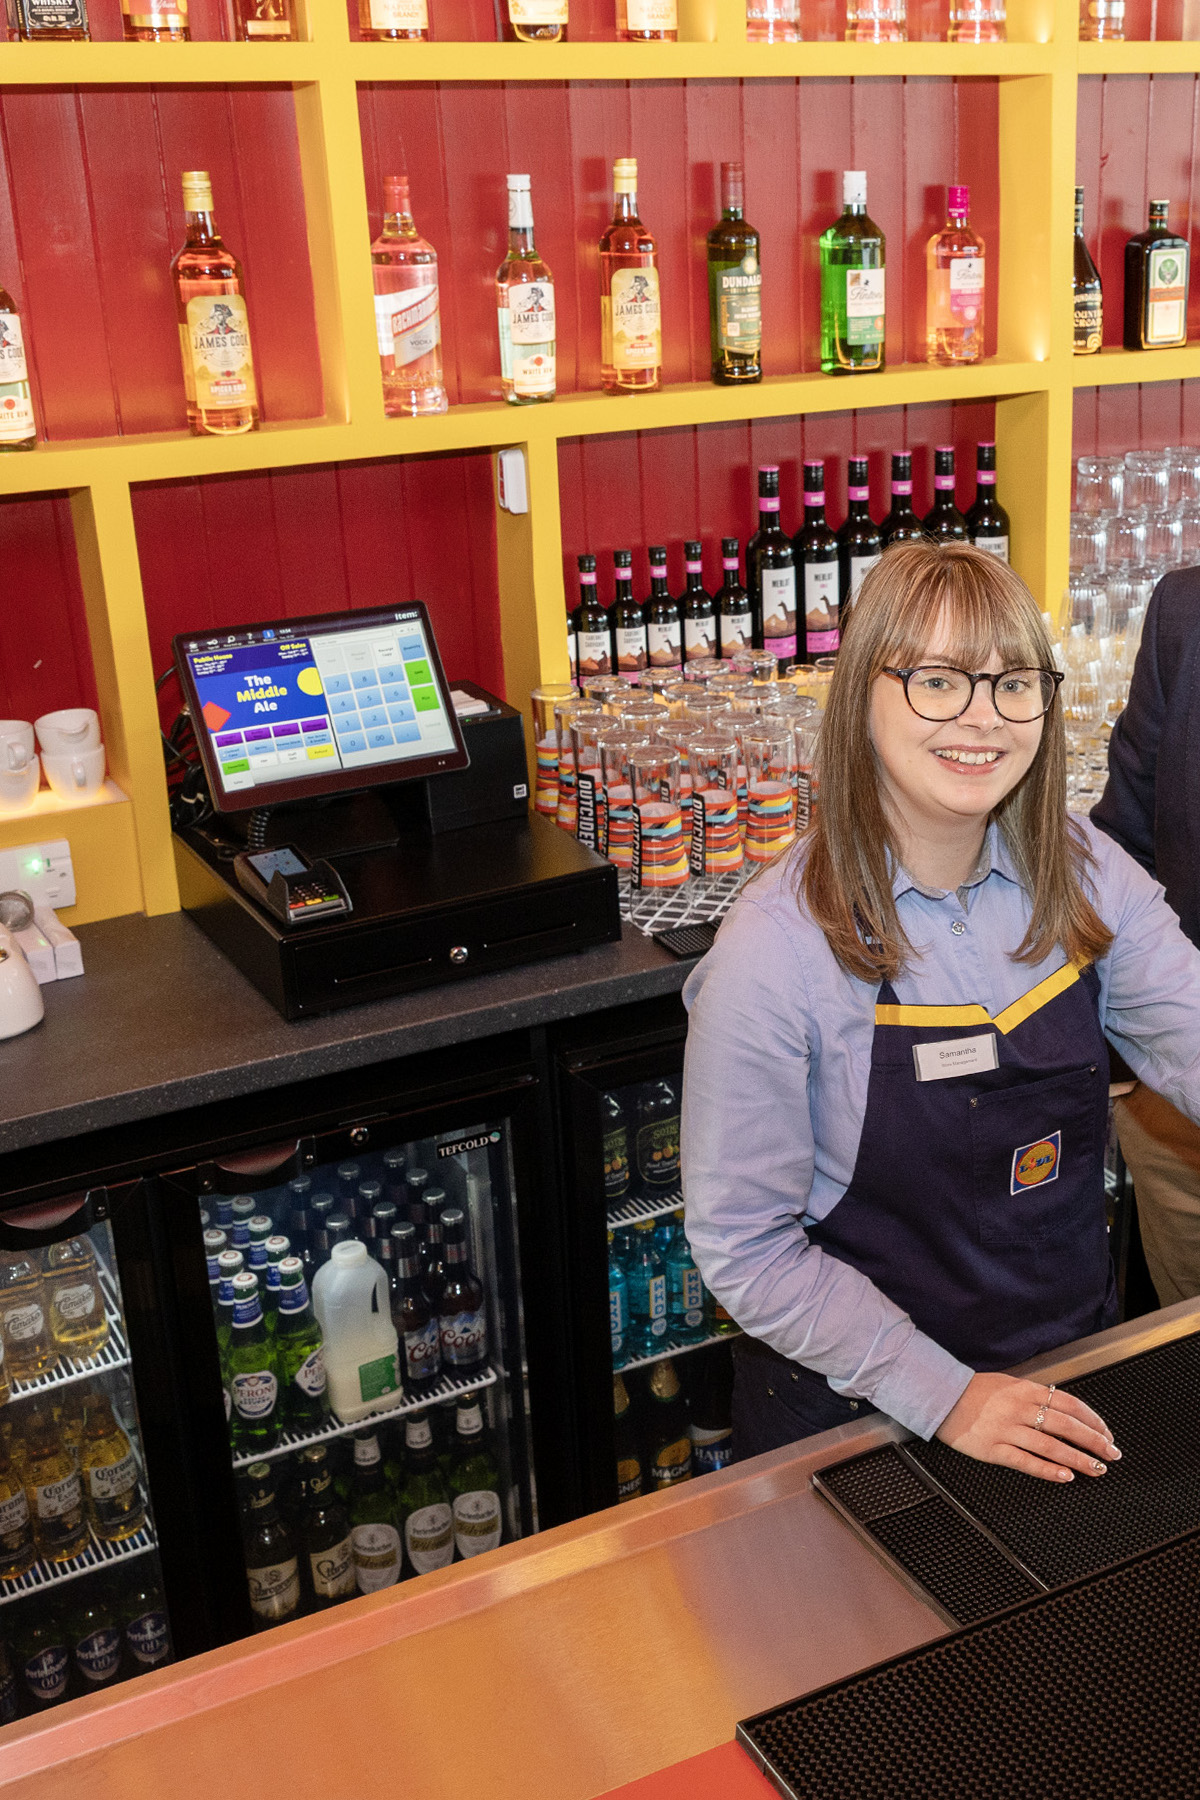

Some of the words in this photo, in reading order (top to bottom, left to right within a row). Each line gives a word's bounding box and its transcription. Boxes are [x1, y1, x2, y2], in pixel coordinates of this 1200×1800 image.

[615, 302, 643, 317] JAMES
[513, 311, 540, 324] JAMES
[194, 336, 227, 349] JAMES
[394, 610, 418, 621] Item:
[193, 655, 213, 664] Public
[213, 653, 233, 661] House
[244, 674, 272, 687] The
[236, 685, 288, 703] Middle
[253, 700, 278, 714] Ale
[939, 1047, 977, 1060] Samantha
[438, 1136, 489, 1158] TEFCOLD
